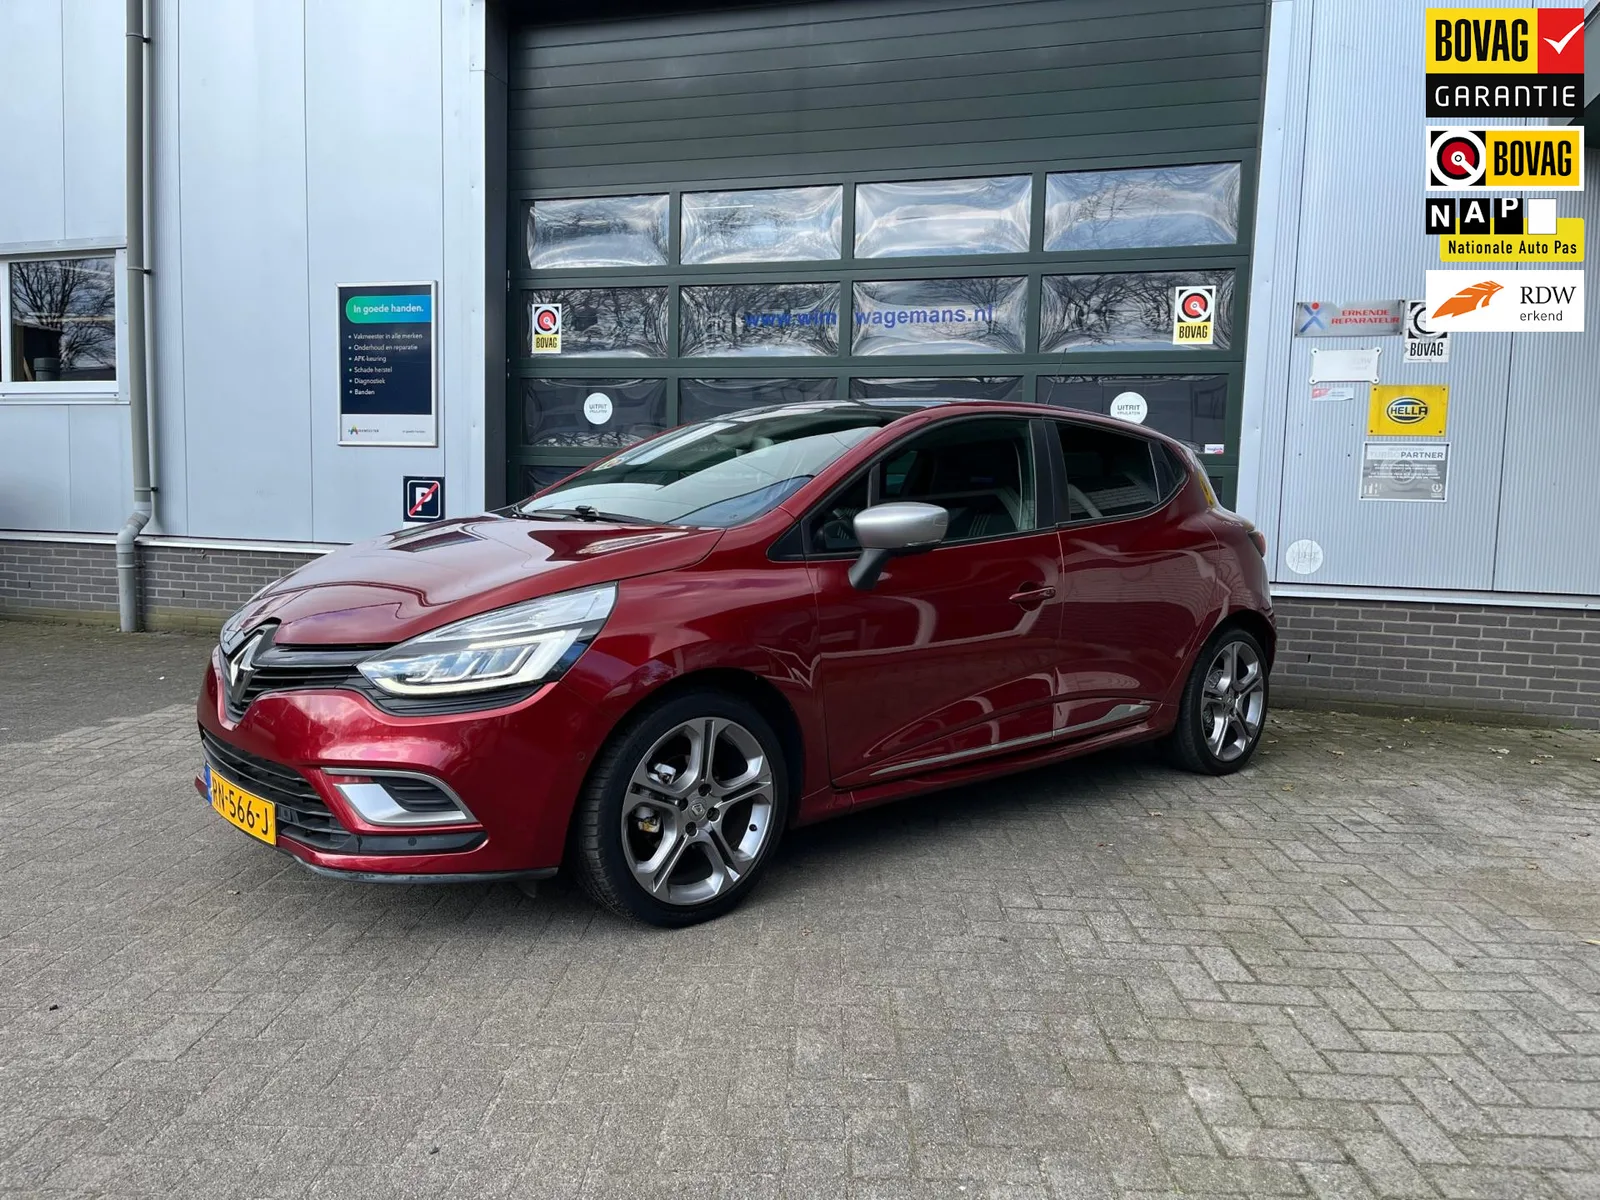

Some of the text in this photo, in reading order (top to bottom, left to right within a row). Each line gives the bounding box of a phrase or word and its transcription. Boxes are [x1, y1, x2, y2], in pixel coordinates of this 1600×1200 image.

[353, 303, 424, 315] In goede handen.
[854, 304, 993, 329] wagemans.nl
[1331, 317, 1400, 325] REPARATEUR
[1179, 325, 1208, 339] BOVAG
[393, 344, 418, 352] reparatie
[536, 337, 557, 348] BOVAG
[1410, 342, 1444, 357] BOVAG
[353, 355, 387, 363] APK-keuring
[1390, 406, 1428, 416] HELLA
[1400, 451, 1444, 459] PARTNER
[212, 776, 269, 836] RN-566-J
